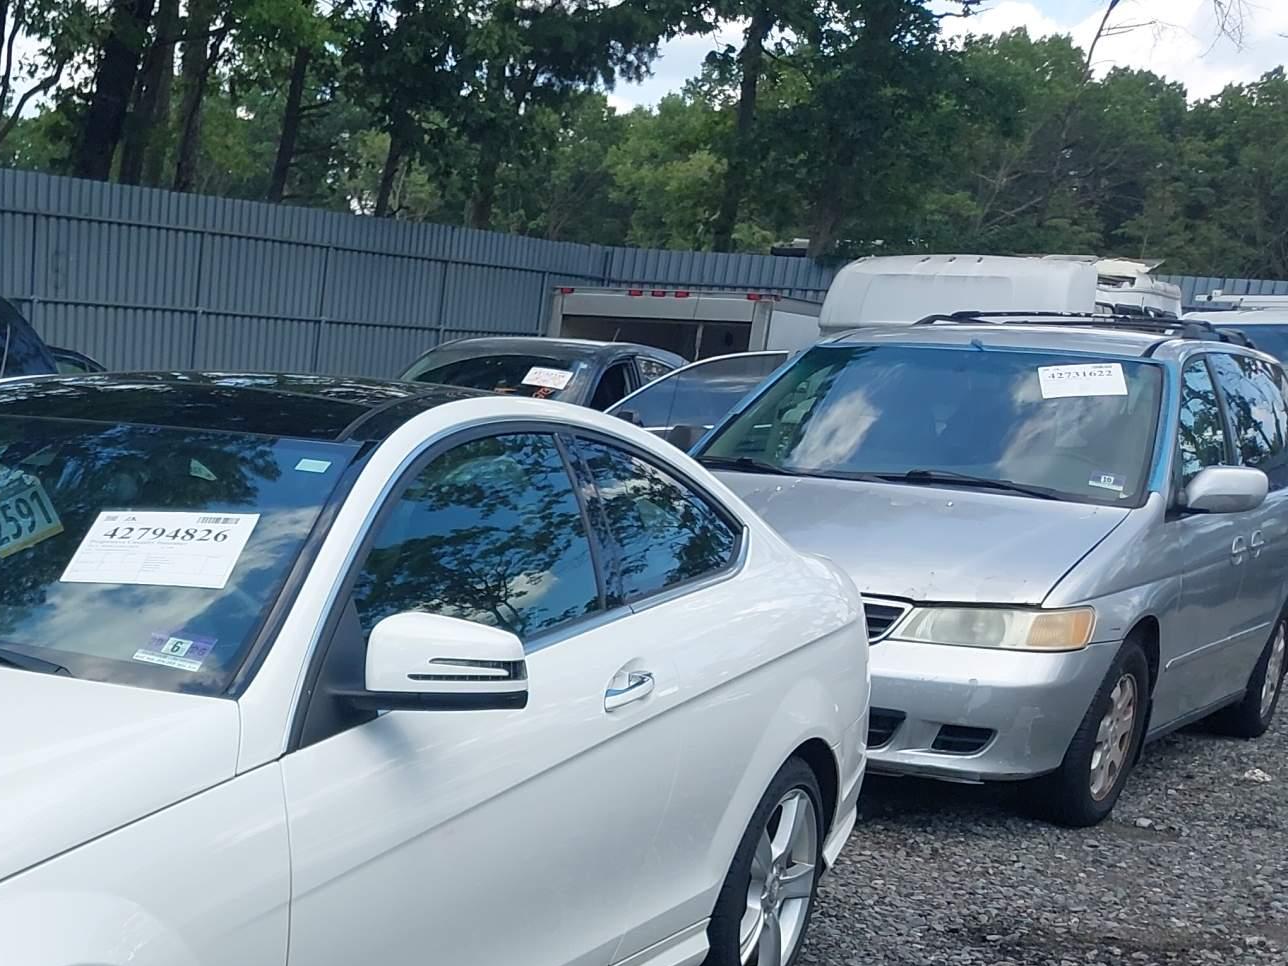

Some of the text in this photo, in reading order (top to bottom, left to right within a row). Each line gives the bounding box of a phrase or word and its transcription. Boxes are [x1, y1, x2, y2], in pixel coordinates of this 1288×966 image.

[1048, 369, 1113, 379] 42731622
[103, 526, 232, 543] 42794826
[170, 640, 183, 653] 6
